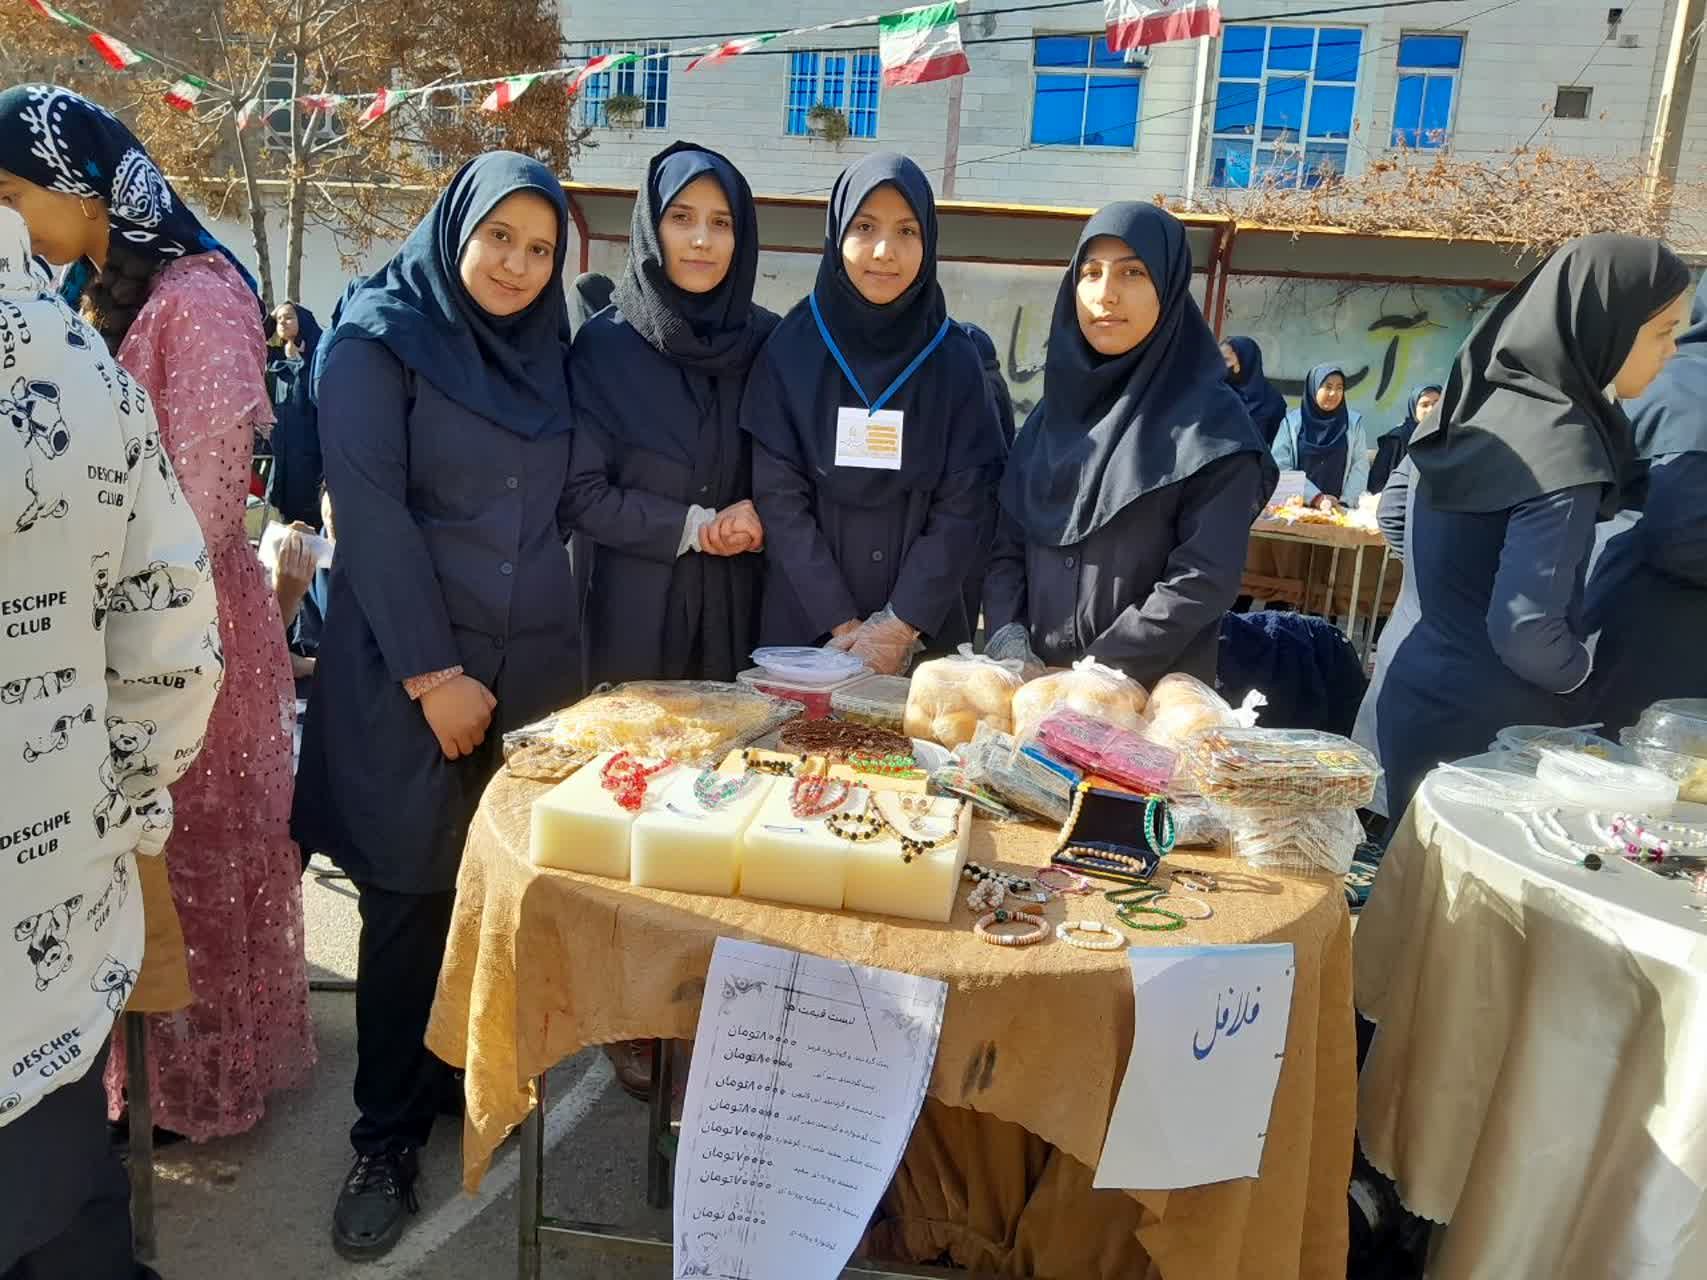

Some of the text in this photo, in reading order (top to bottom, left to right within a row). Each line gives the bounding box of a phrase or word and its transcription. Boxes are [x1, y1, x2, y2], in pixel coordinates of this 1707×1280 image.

[0, 309, 16, 369] DESC
[98, 490, 124, 507] CLUB
[6, 617, 51, 638] CLUB
[0, 810, 72, 850] DESCHPE
[17, 838, 58, 864] CLUB
[1193, 985, 1261, 1060] فلافل
[12, 1026, 81, 1077] DESCHPE
[39, 1044, 81, 1078] CLUB
